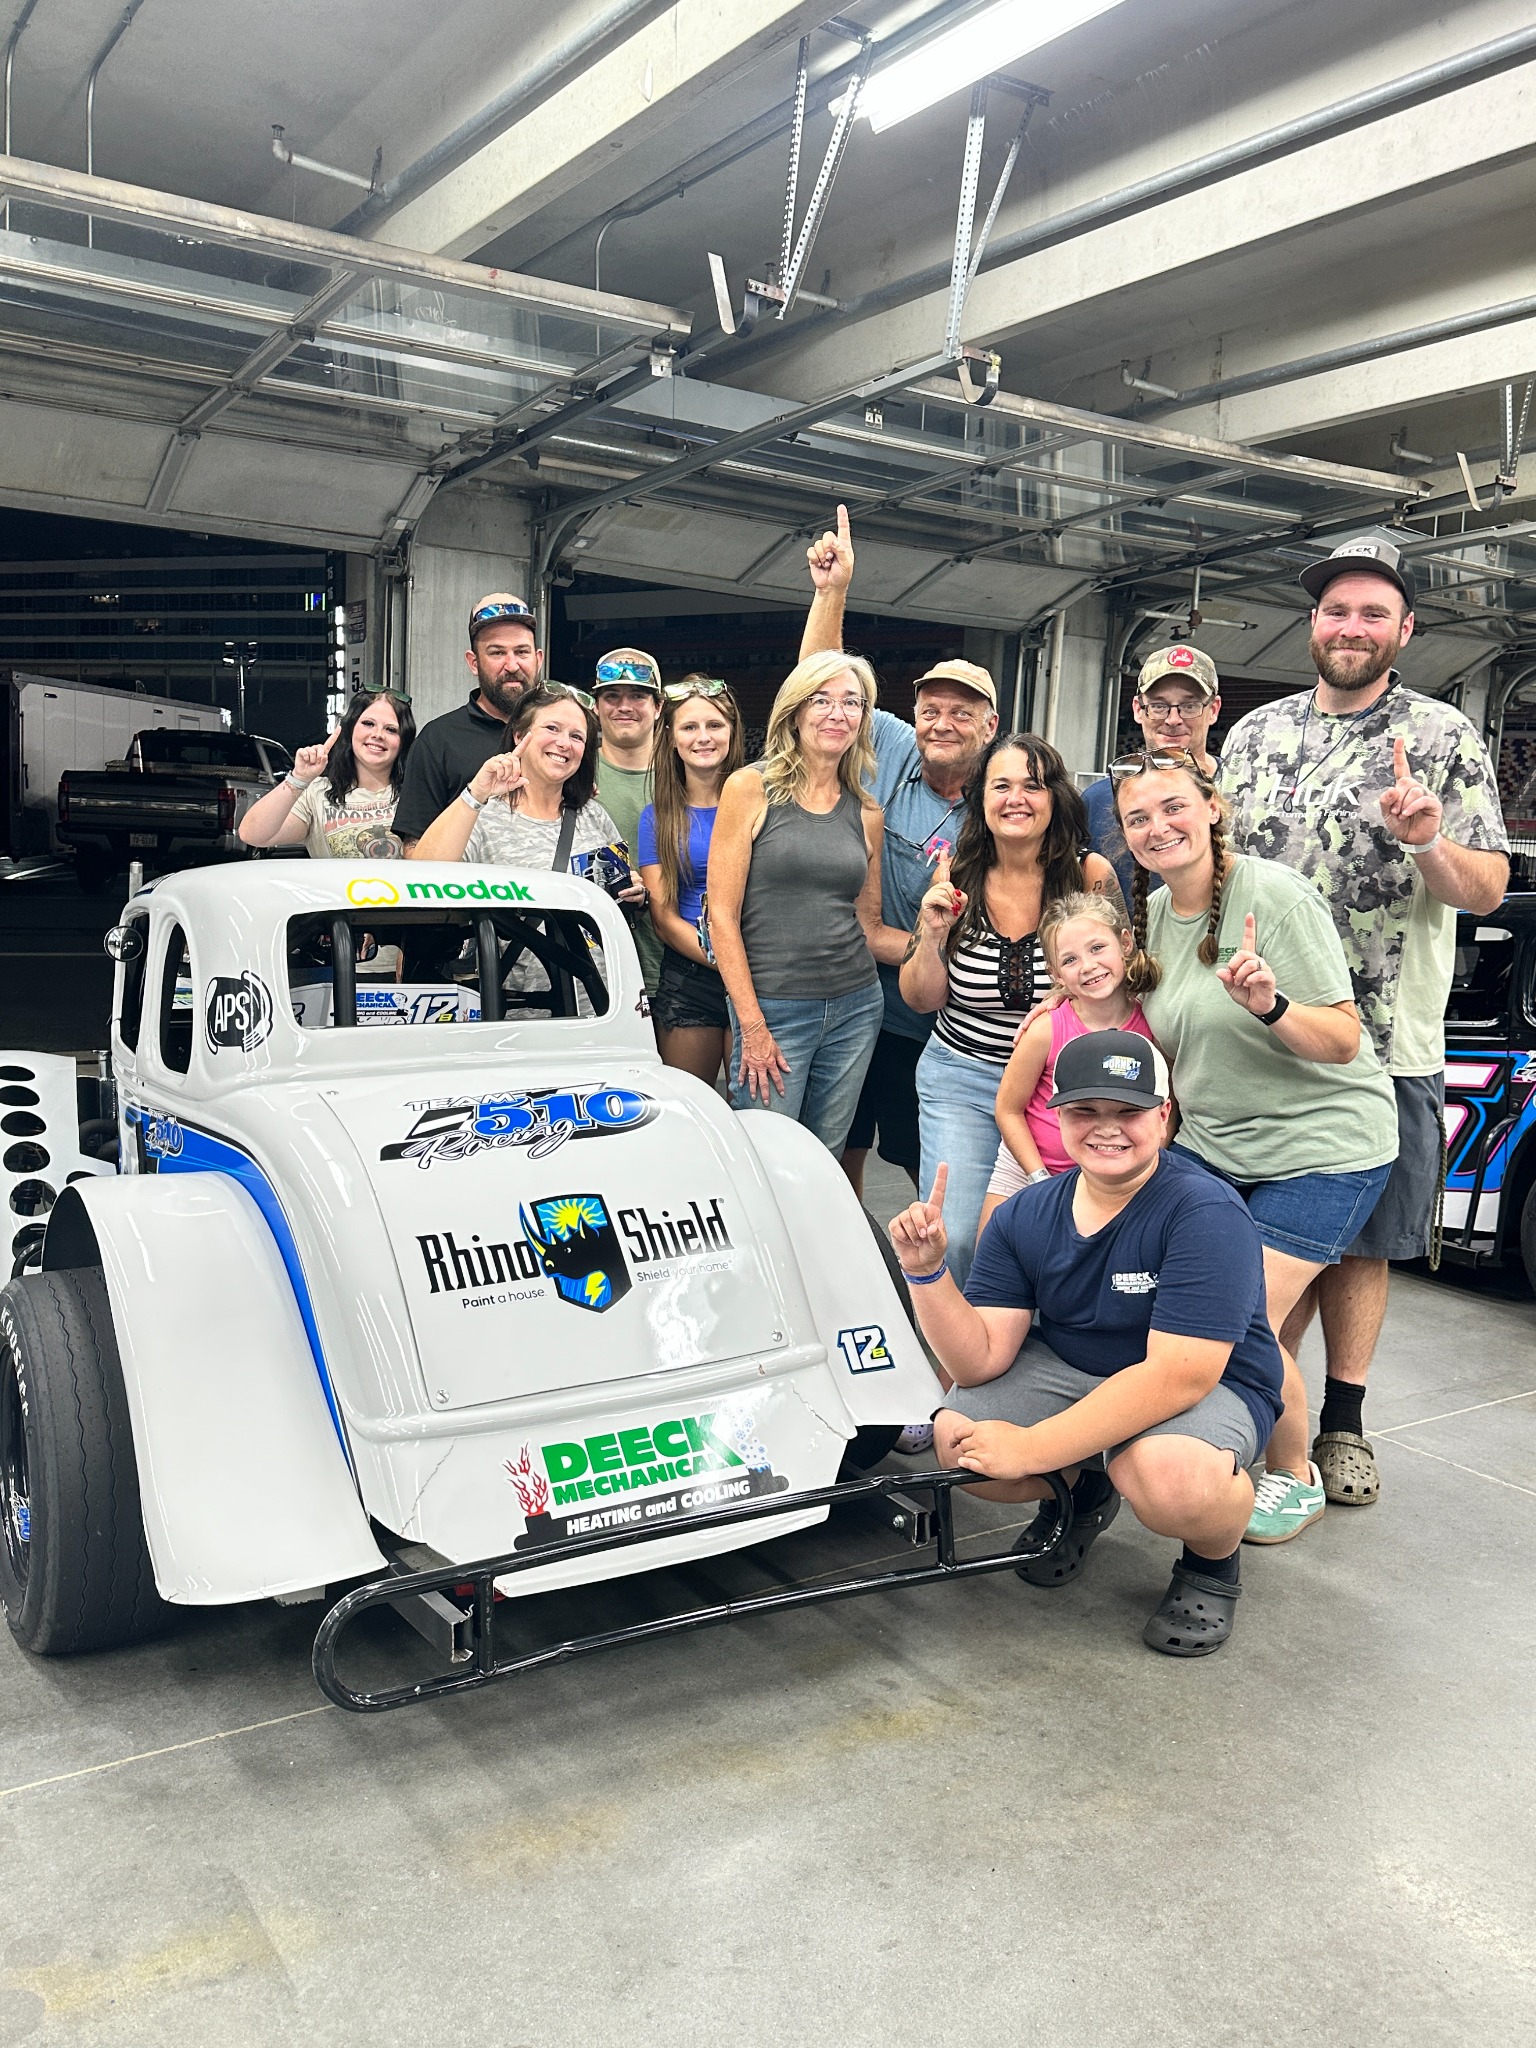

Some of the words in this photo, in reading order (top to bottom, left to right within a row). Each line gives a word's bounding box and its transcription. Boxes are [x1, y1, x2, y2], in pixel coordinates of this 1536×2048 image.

[406, 880, 536, 902] modak
[214, 991, 251, 1034] APS
[356, 993, 398, 1008] EECK
[404, 1092, 518, 1112] TEAM
[472, 1088, 650, 1139] 510
[401, 1118, 579, 1169] Racing
[415, 1231, 542, 1295] Rhino
[636, 1268, 671, 1283] Shield
[673, 1264, 698, 1281] your
[1115, 1272, 1155, 1283] DEECK
[461, 1293, 495, 1309] Paint
[497, 1293, 506, 1304] a
[838, 1326, 895, 1375] 12
[541, 1413, 746, 1484] DEECK
[552, 1453, 728, 1507] MECHANICAL
[566, 1504, 642, 1536] HEATING
[645, 1496, 677, 1518] and
[680, 1480, 751, 1510] COOLING
